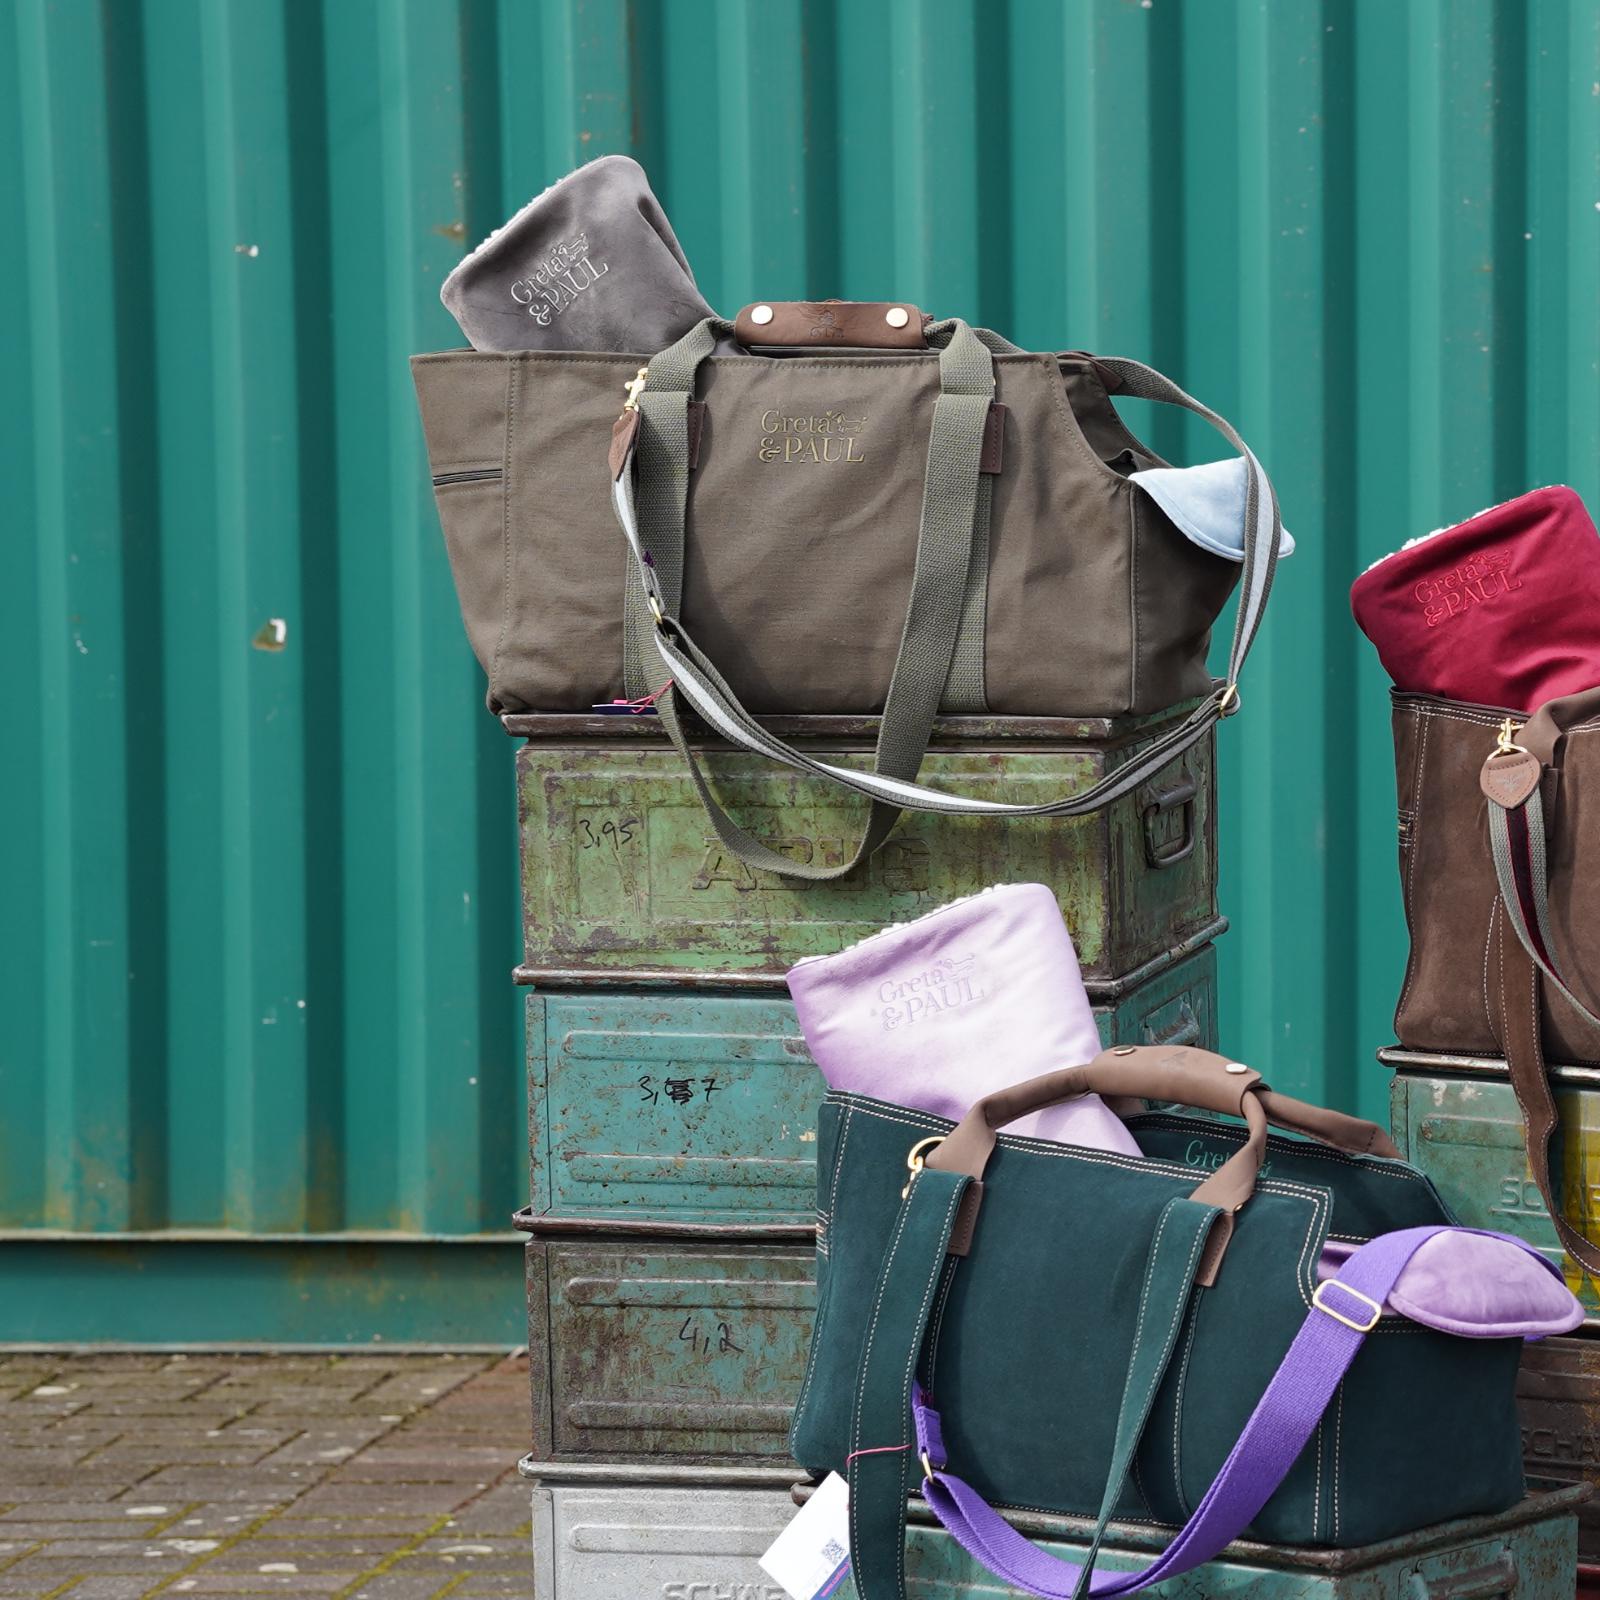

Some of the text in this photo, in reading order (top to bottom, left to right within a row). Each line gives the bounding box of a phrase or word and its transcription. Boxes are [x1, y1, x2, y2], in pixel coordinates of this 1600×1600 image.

[510, 256, 567, 304] Greta
[761, 410, 834, 434] Greta
[1414, 564, 1479, 604] Greta
[880, 968, 946, 1003] Greta
